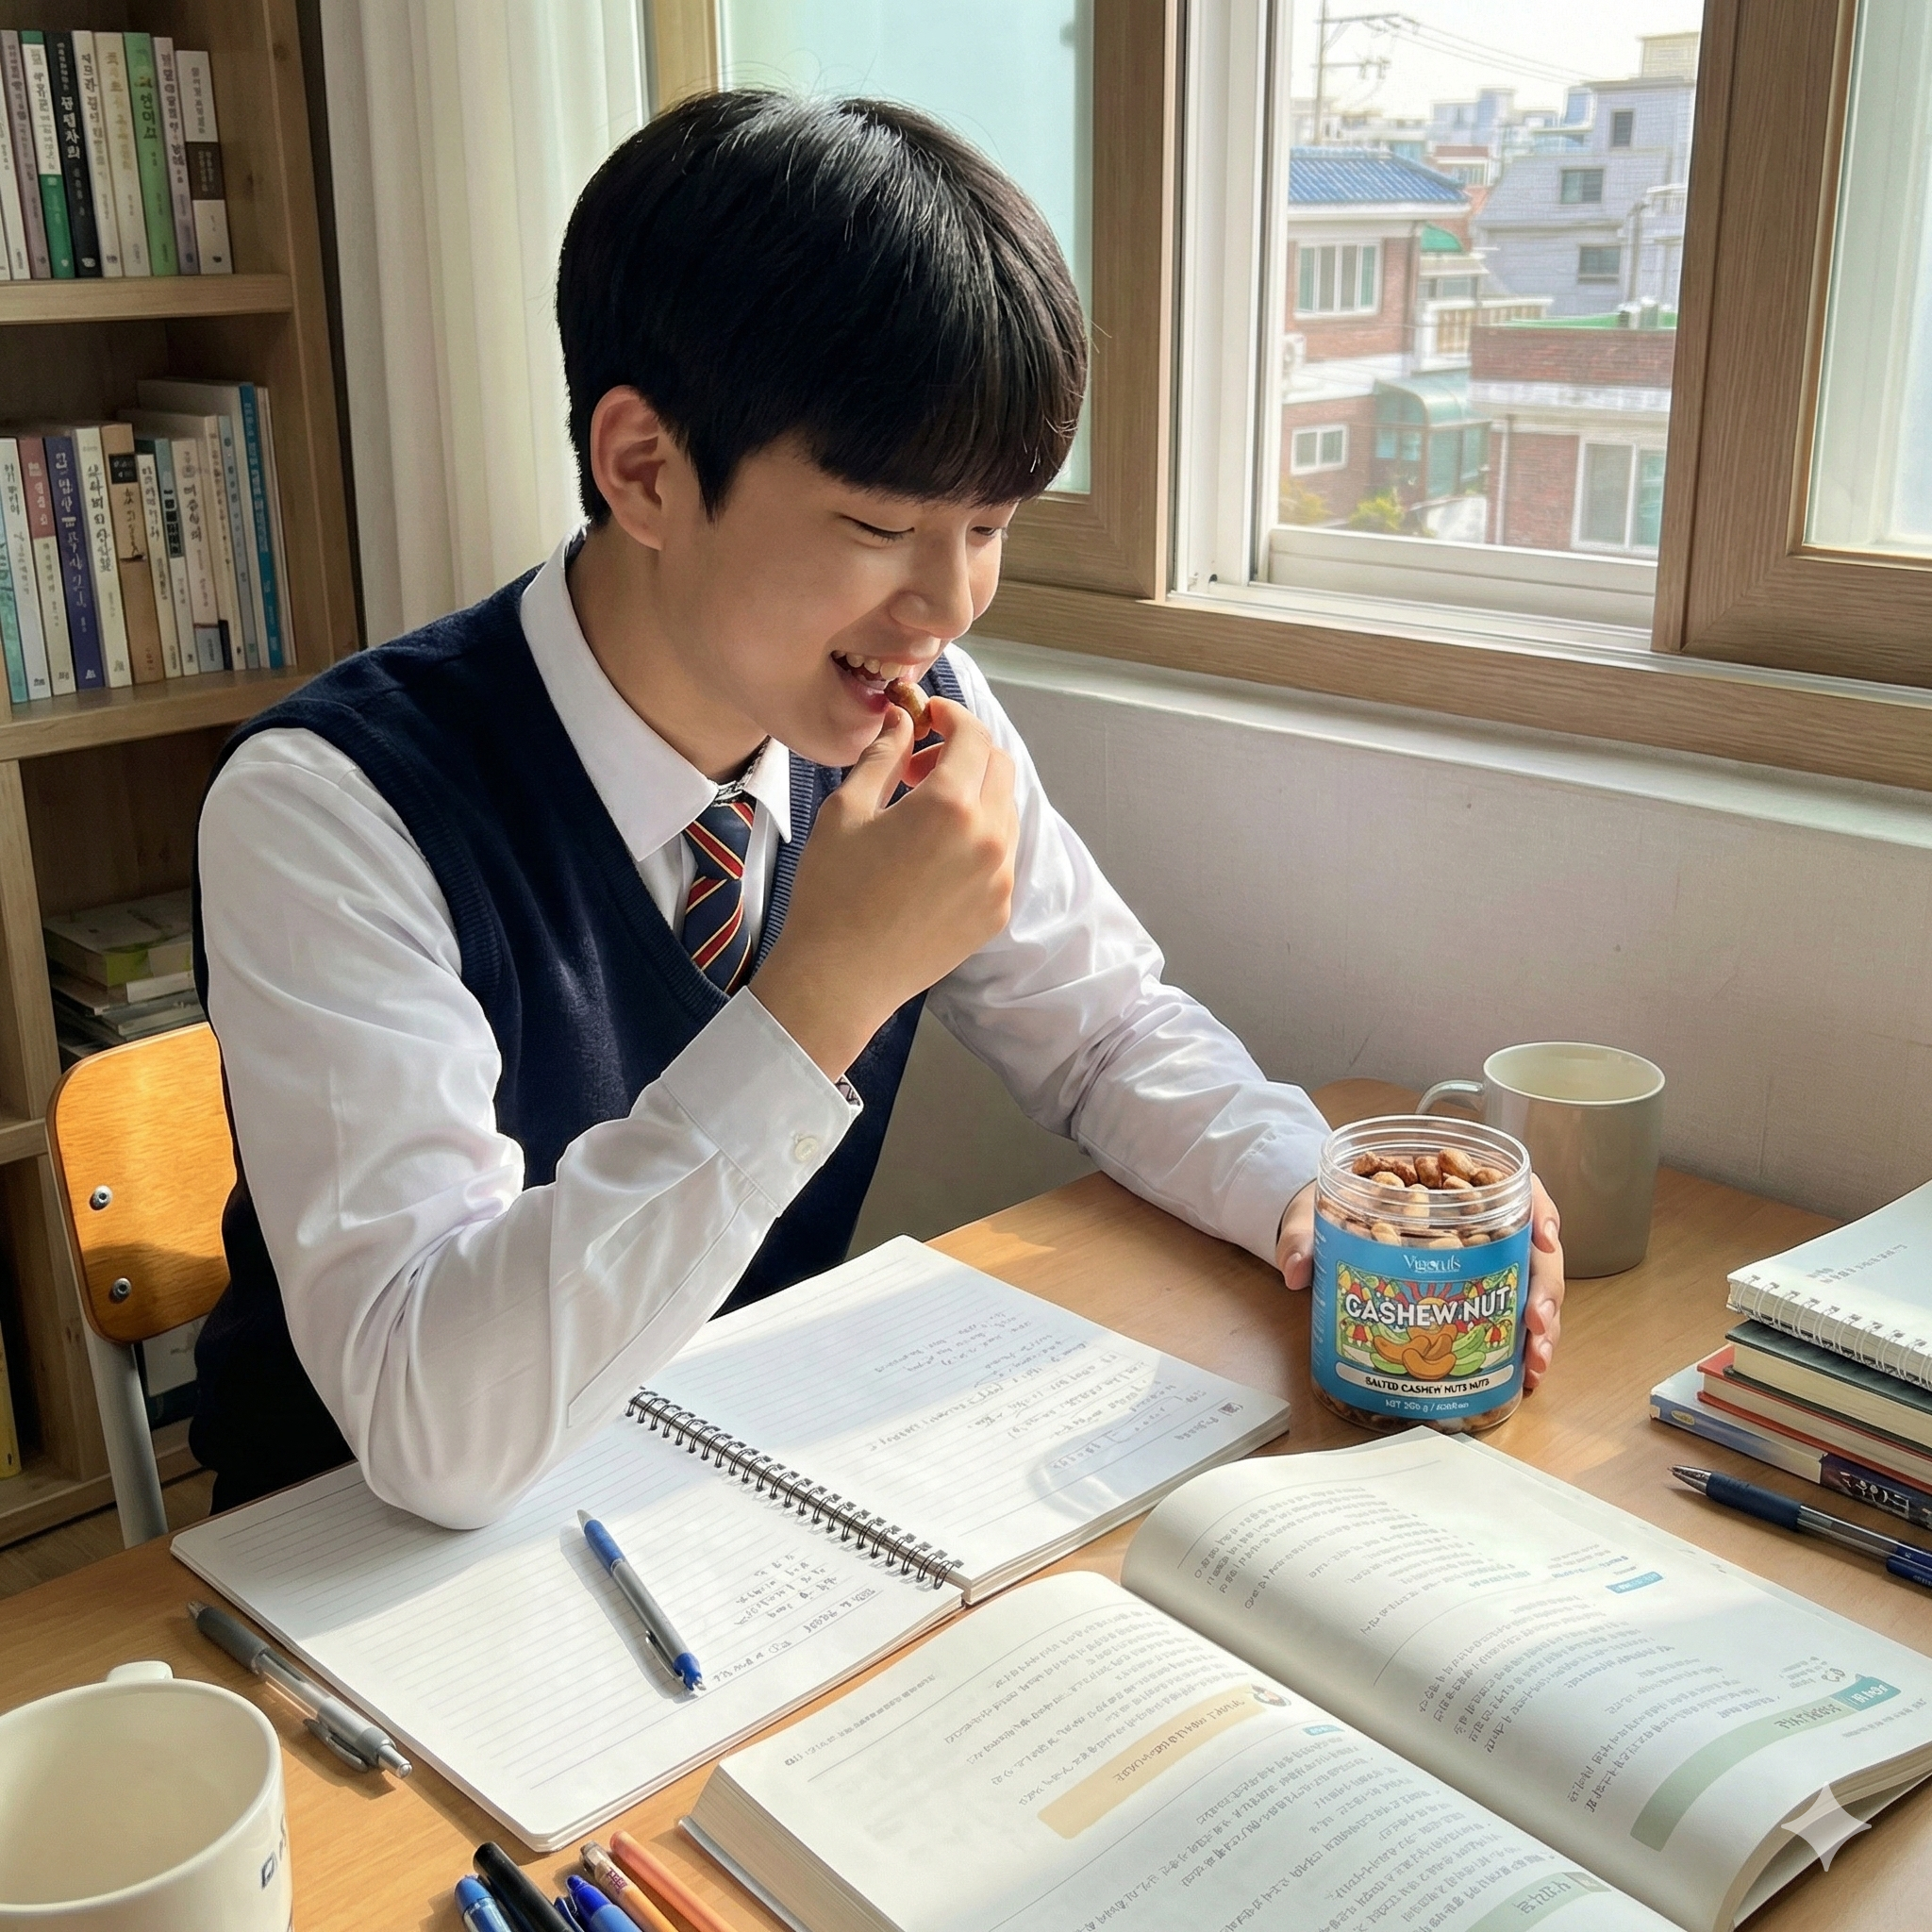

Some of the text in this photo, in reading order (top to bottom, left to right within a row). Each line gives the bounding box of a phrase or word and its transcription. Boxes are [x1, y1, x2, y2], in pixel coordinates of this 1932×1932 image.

[1345, 1286, 1510, 1327] CASHEW NUT
[1401, 1383, 1443, 1394] CASHEW
